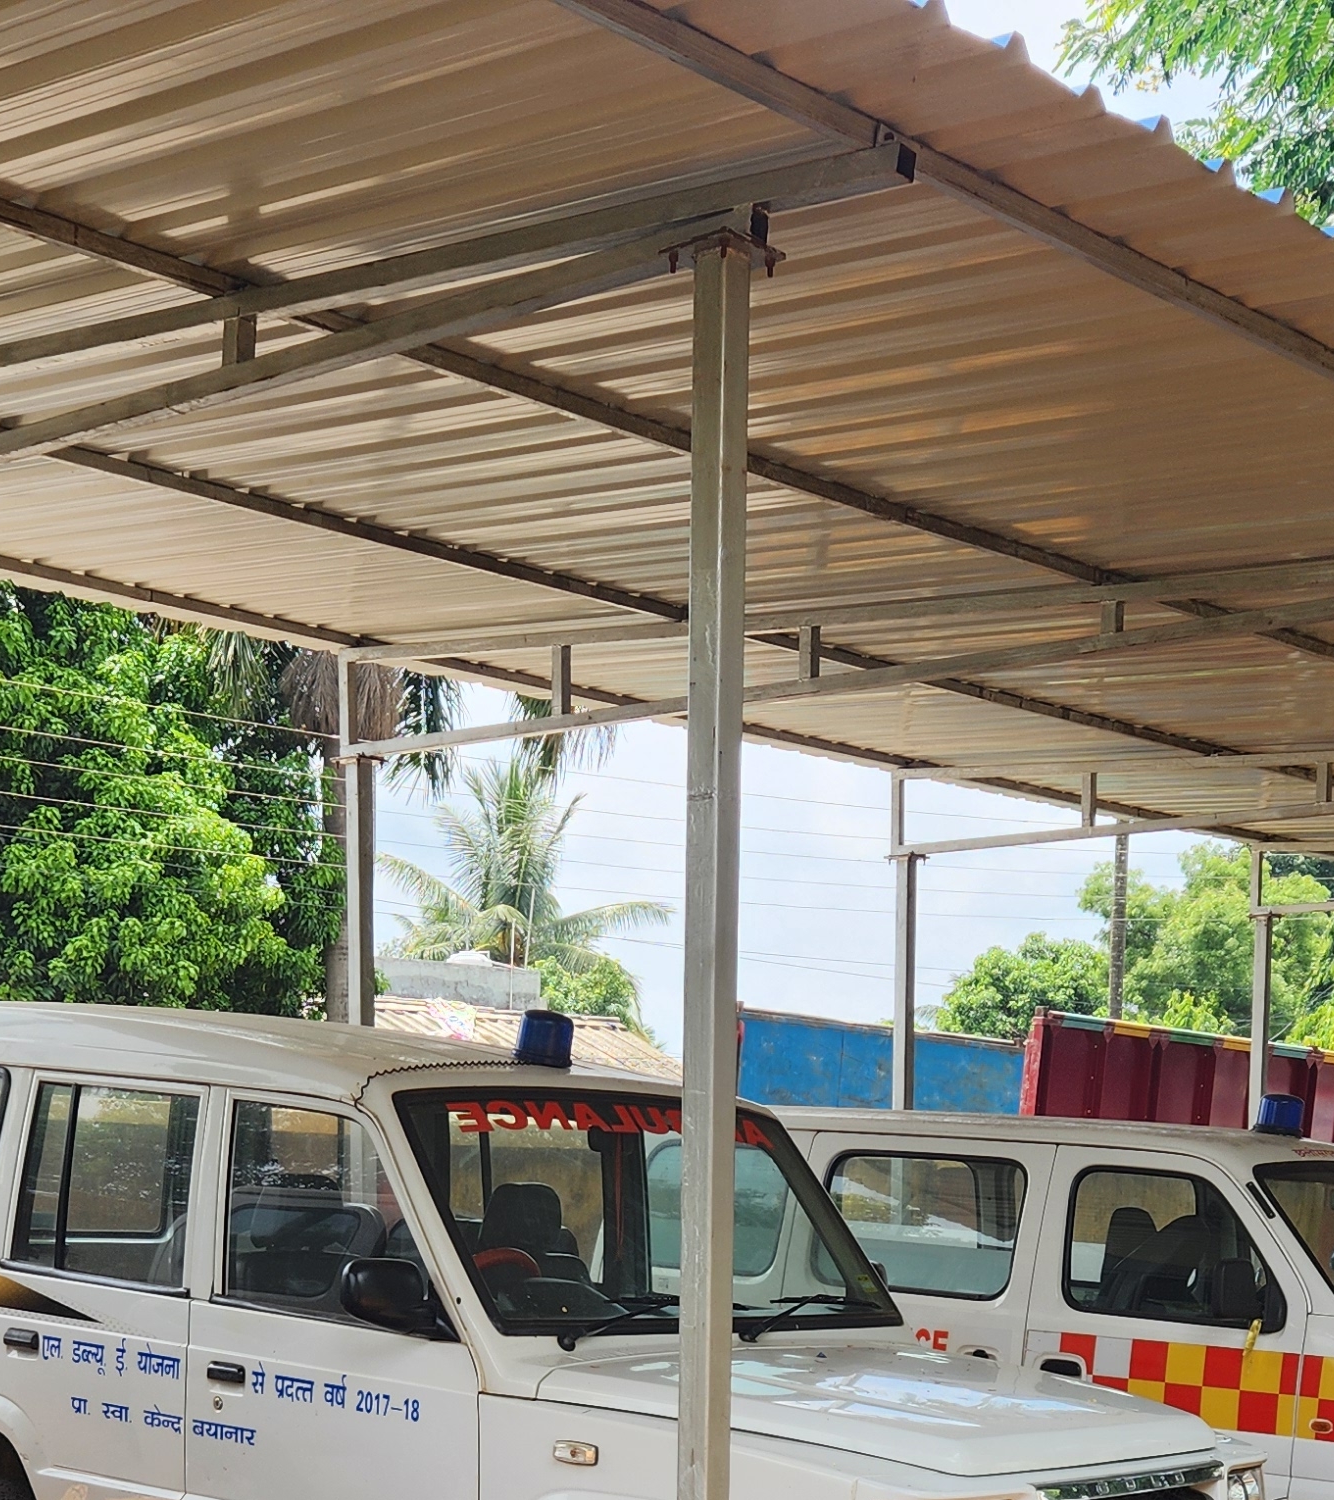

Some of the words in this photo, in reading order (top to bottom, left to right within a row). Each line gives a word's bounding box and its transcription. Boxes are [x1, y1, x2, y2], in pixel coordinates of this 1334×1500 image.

[42, 1334, 64, 1360] एल.
[137, 1342, 181, 1380] योजना
[252, 1361, 266, 1395] से
[274, 1374, 315, 1404] प्रदत्त
[324, 1374, 348, 1409] वर्ष
[71, 1397, 91, 1416] प्रा.
[102, 1402, 133, 1424] स्वा.
[144, 1404, 183, 1435] केन्द्र
[192, 1419, 256, 1446] बयानार
